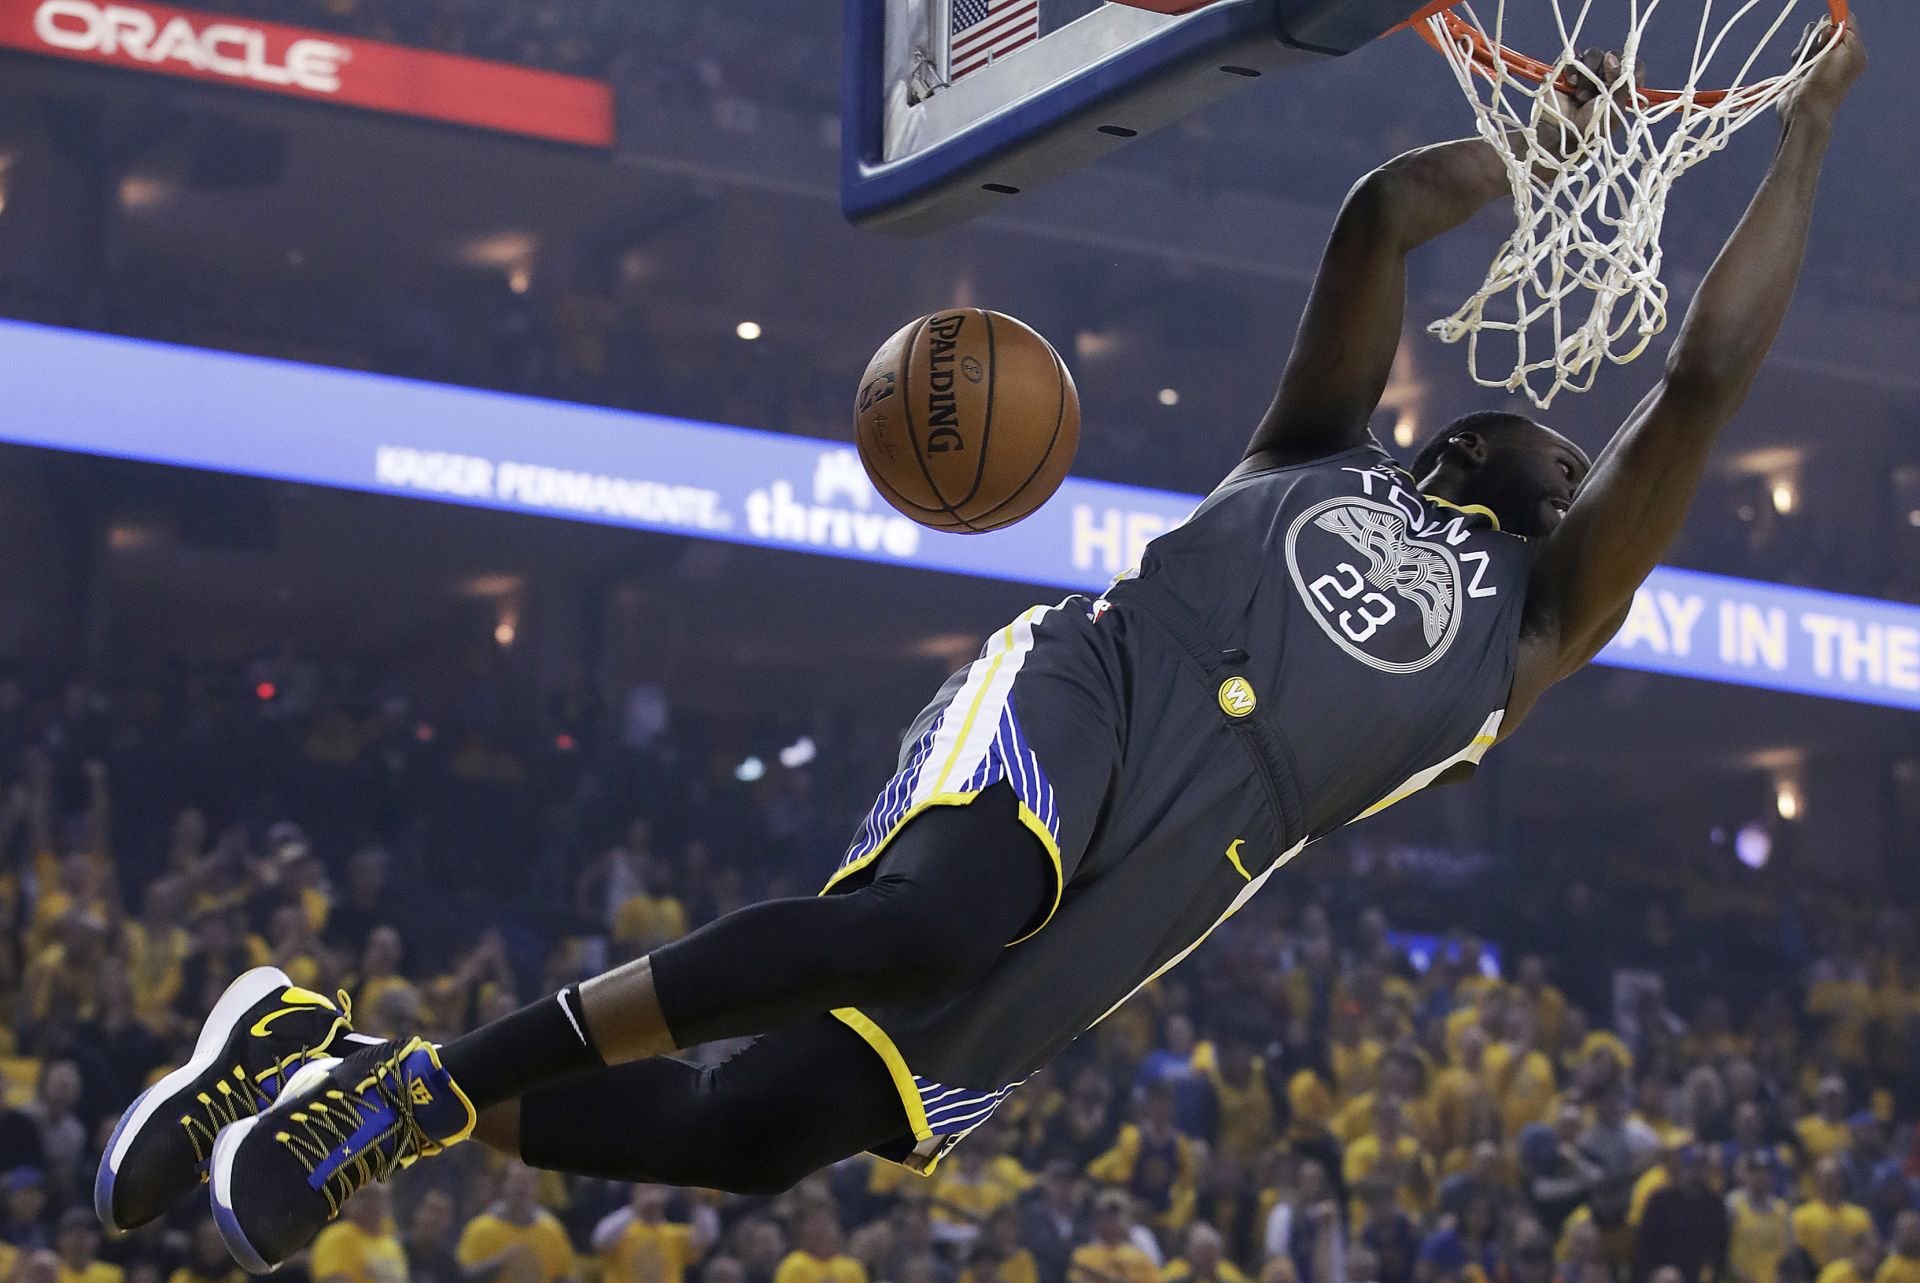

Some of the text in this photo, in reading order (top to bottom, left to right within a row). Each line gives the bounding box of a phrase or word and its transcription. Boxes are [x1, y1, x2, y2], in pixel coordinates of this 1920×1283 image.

[33, 0, 343, 92] ORACLE
[928, 315, 965, 453] SPALDING
[745, 479, 921, 557] thrive
[1073, 503, 1186, 572] HE
[1341, 467, 1497, 598] TOWN
[1309, 562, 1396, 643] 23
[1616, 586, 1920, 691] AY IN THE
